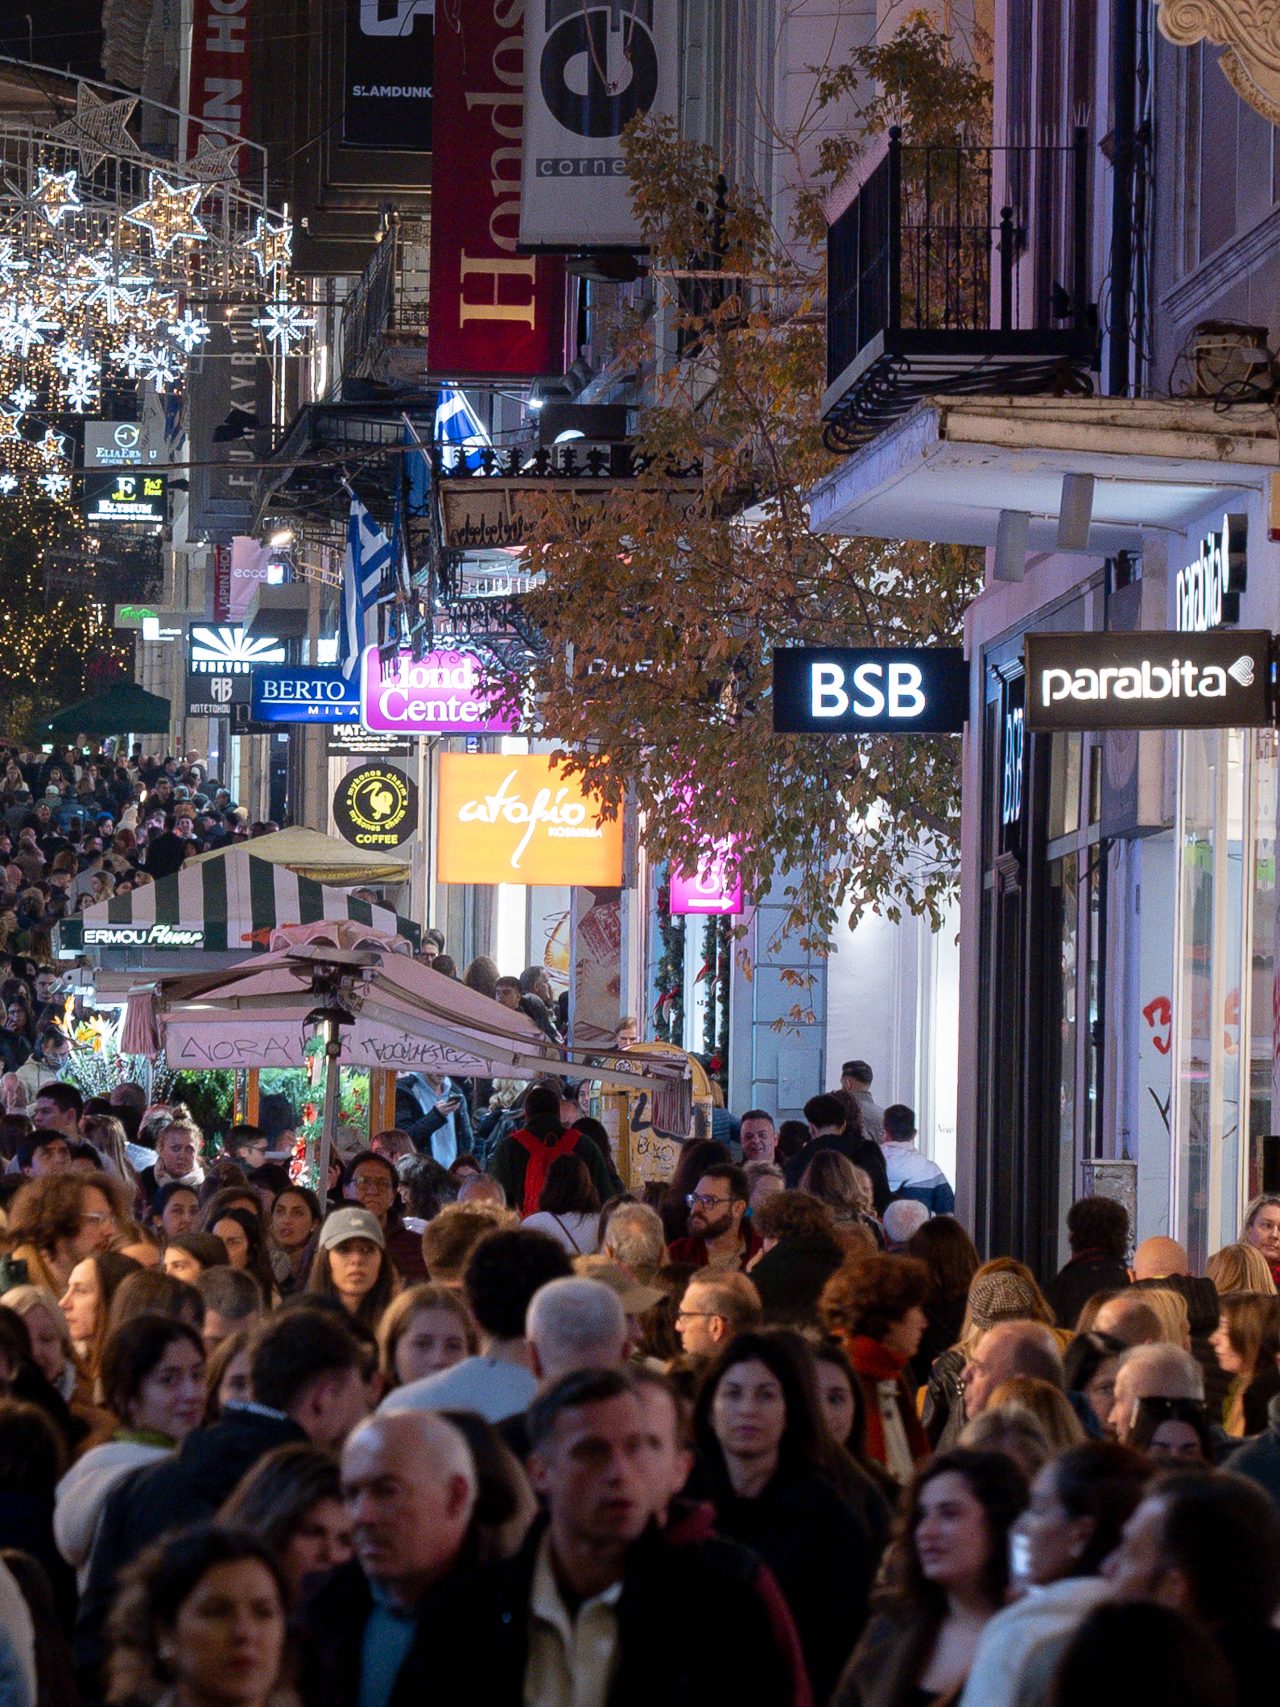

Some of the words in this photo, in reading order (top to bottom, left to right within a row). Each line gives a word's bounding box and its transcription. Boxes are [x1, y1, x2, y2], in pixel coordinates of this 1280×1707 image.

[234, 569, 267, 578] ecco
[812, 663, 926, 717] BSB
[1042, 658, 1227, 706] parabita
[356, 833, 399, 844] COFFEE
[84, 930, 146, 943] ERMOU
[148, 925, 202, 944] Flower
